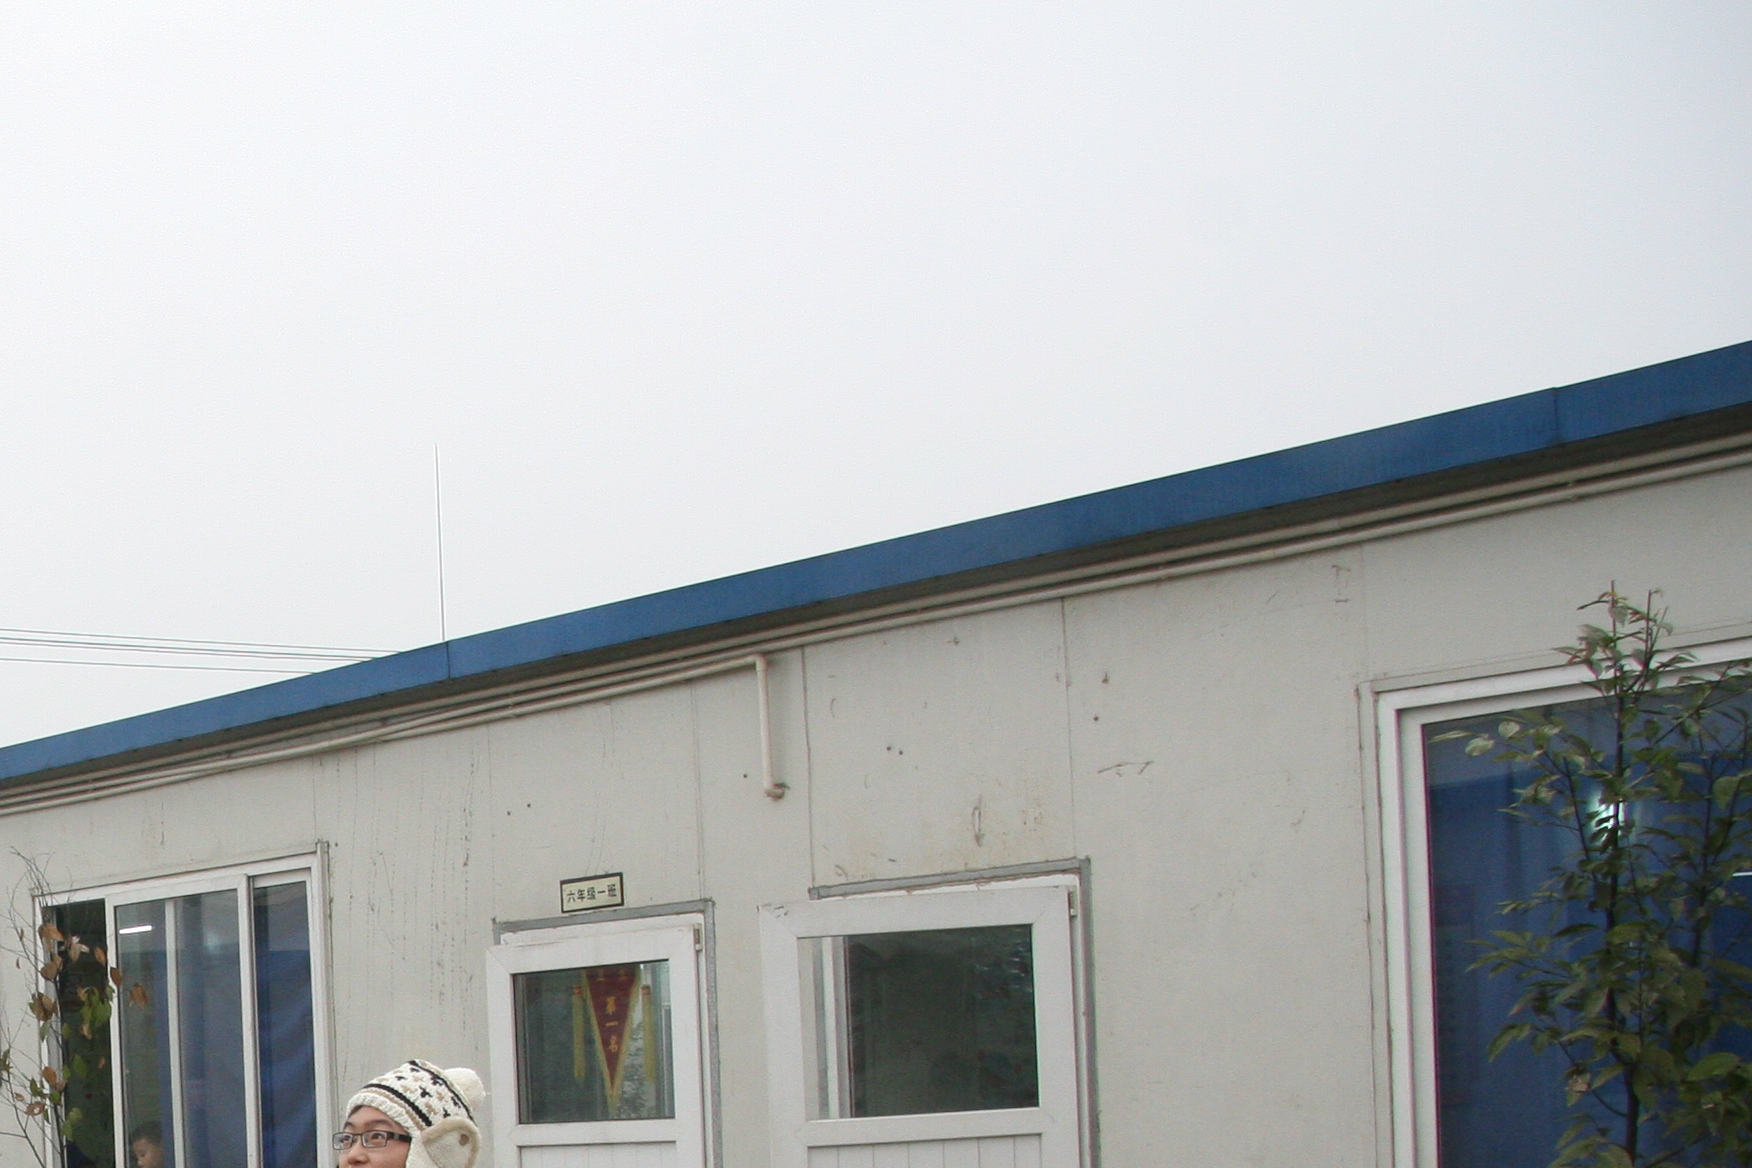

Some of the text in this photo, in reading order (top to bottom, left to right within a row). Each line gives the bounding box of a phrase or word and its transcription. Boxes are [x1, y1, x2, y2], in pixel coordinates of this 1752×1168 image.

[567, 884, 616, 902] 六年级一班
[605, 996, 618, 1053] 第一名
